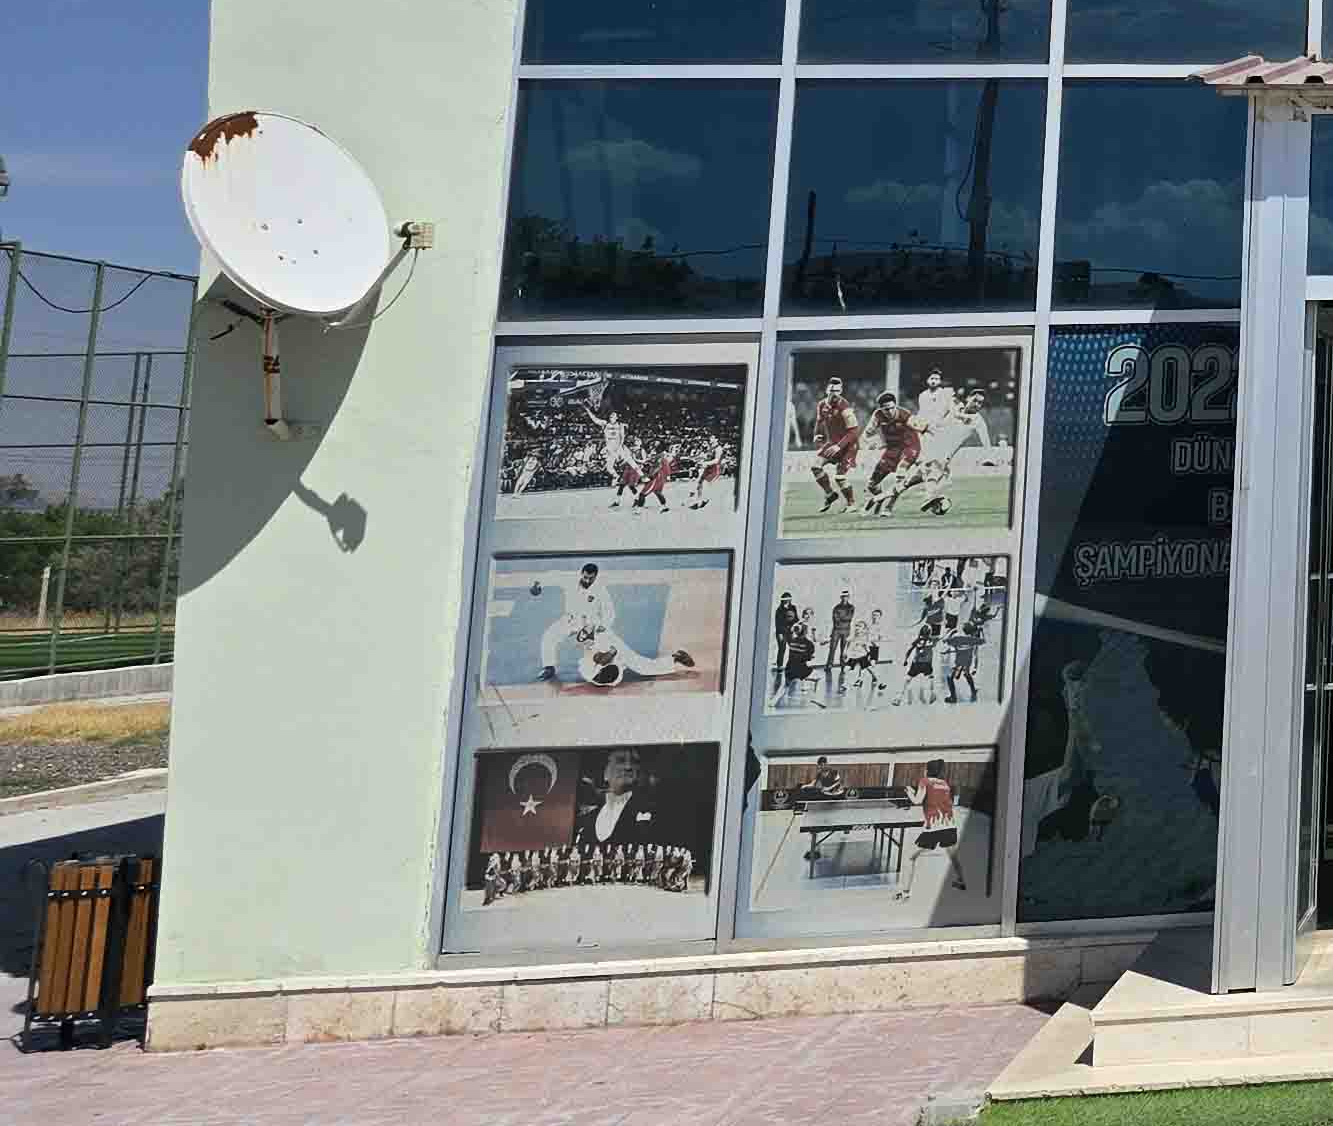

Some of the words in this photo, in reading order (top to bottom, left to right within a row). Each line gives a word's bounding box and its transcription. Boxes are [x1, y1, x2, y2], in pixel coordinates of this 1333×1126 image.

[1103, 343, 1237, 425] 202
[1171, 432, 1234, 474] DÜN
[1074, 536, 1231, 585] ŞAMPİYONA
